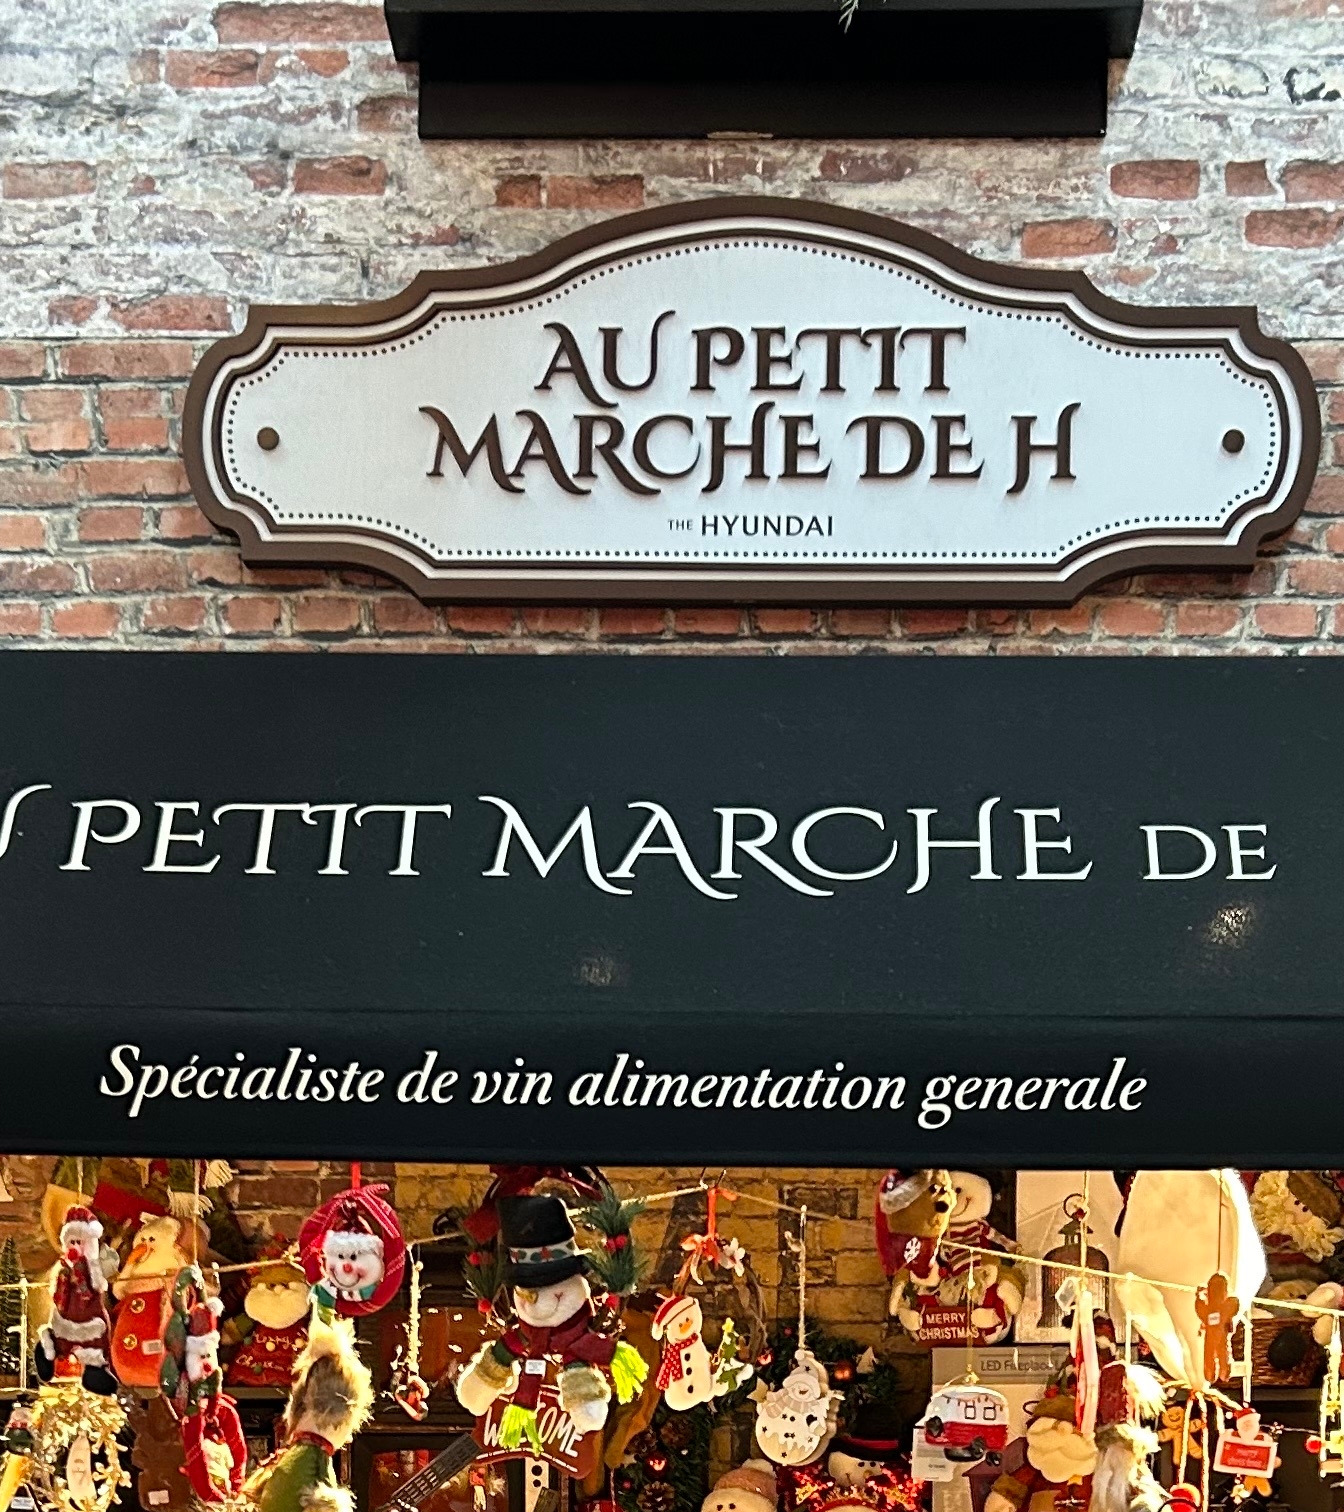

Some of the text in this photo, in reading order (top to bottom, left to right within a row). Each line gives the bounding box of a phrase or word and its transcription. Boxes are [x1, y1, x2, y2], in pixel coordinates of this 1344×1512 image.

[534, 311, 966, 409] AU PETIT
[419, 401, 1081, 496] MARCHE DE H
[668, 515, 833, 536] THE HYUNDAI
[59, 799, 452, 876] PETIT
[478, 796, 1093, 900] MARCHE
[1140, 825, 1277, 880] DE
[100, 1044, 1148, 1130] Spécialiste de vin alimentation generale
[918, 1326, 981, 1341] CHRISTMAS
[925, 1312, 966, 1325] MERRY
